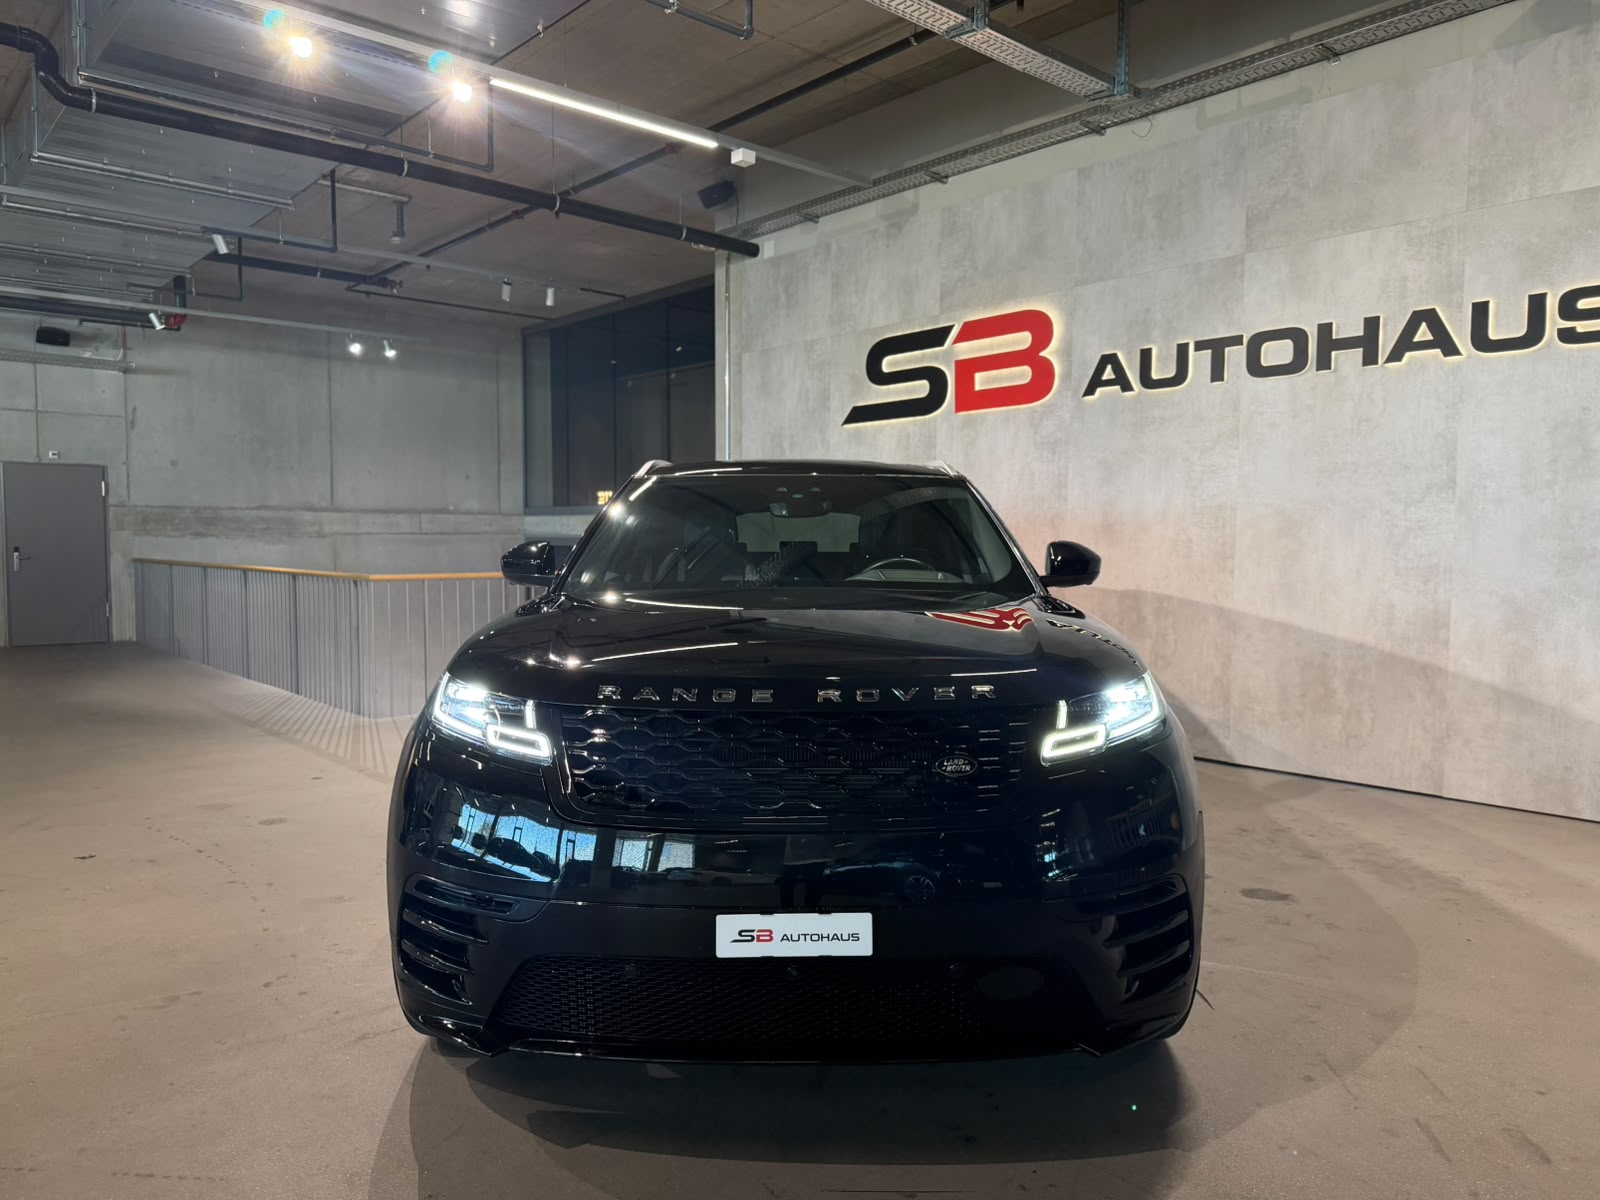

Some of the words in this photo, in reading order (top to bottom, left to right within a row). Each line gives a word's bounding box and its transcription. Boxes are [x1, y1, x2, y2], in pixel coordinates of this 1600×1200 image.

[841, 309, 1057, 426] SB
[597, 684, 774, 703] RANGE
[817, 684, 997, 703] ROVER
[943, 758, 965, 766] LAND
[945, 764, 971, 772] ROVER
[729, 928, 774, 944] SB
[780, 932, 860, 943] AUTOHAUS
